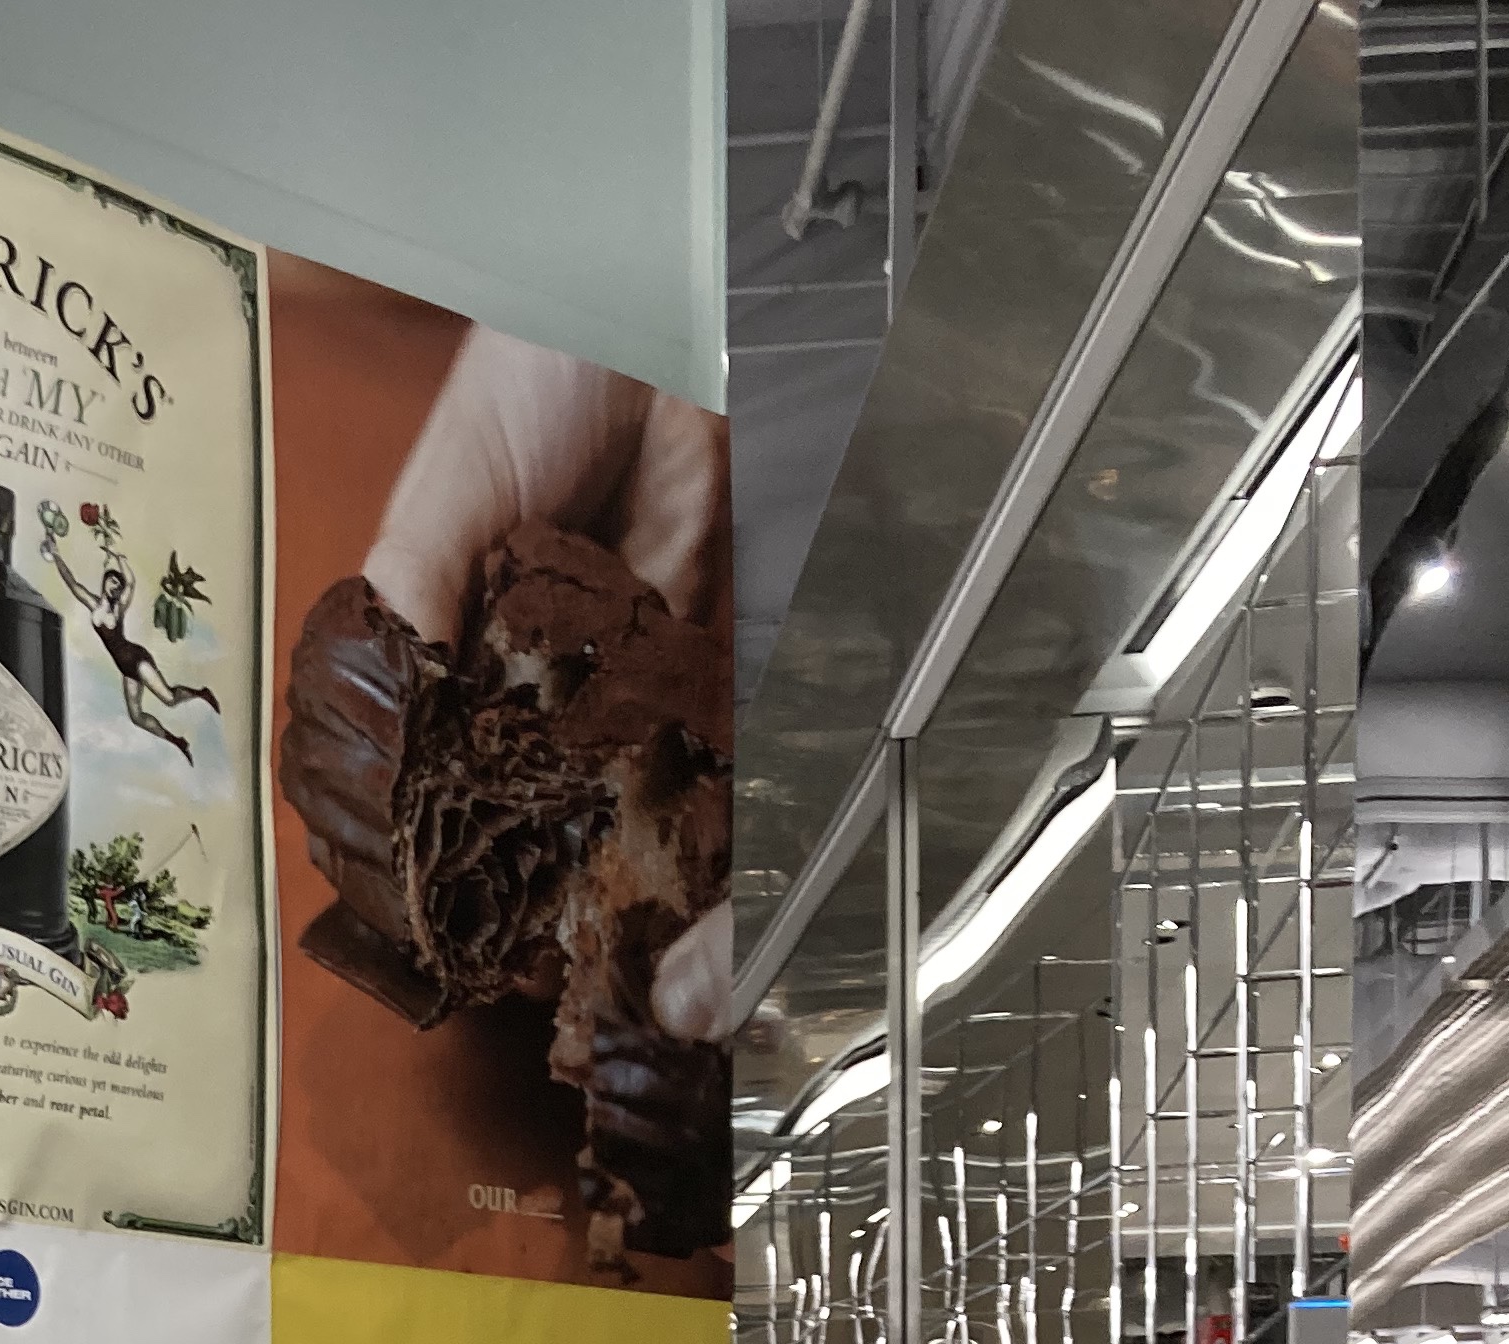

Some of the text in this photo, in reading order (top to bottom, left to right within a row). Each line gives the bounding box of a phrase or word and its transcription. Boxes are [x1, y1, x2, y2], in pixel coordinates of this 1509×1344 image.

[3, 330, 58, 368] between
[7, 405, 60, 442] DRINK
[61, 426, 95, 452] ANY
[97, 440, 145, 472] OTHER
[4, 1033, 16, 1047] to
[19, 1036, 80, 1061] experience
[125, 1052, 168, 1076] delights
[46, 1068, 87, 1089] curious
[23, 1093, 45, 1110] and
[49, 1100, 75, 1115] rose
[467, 1183, 518, 1213] OUR
